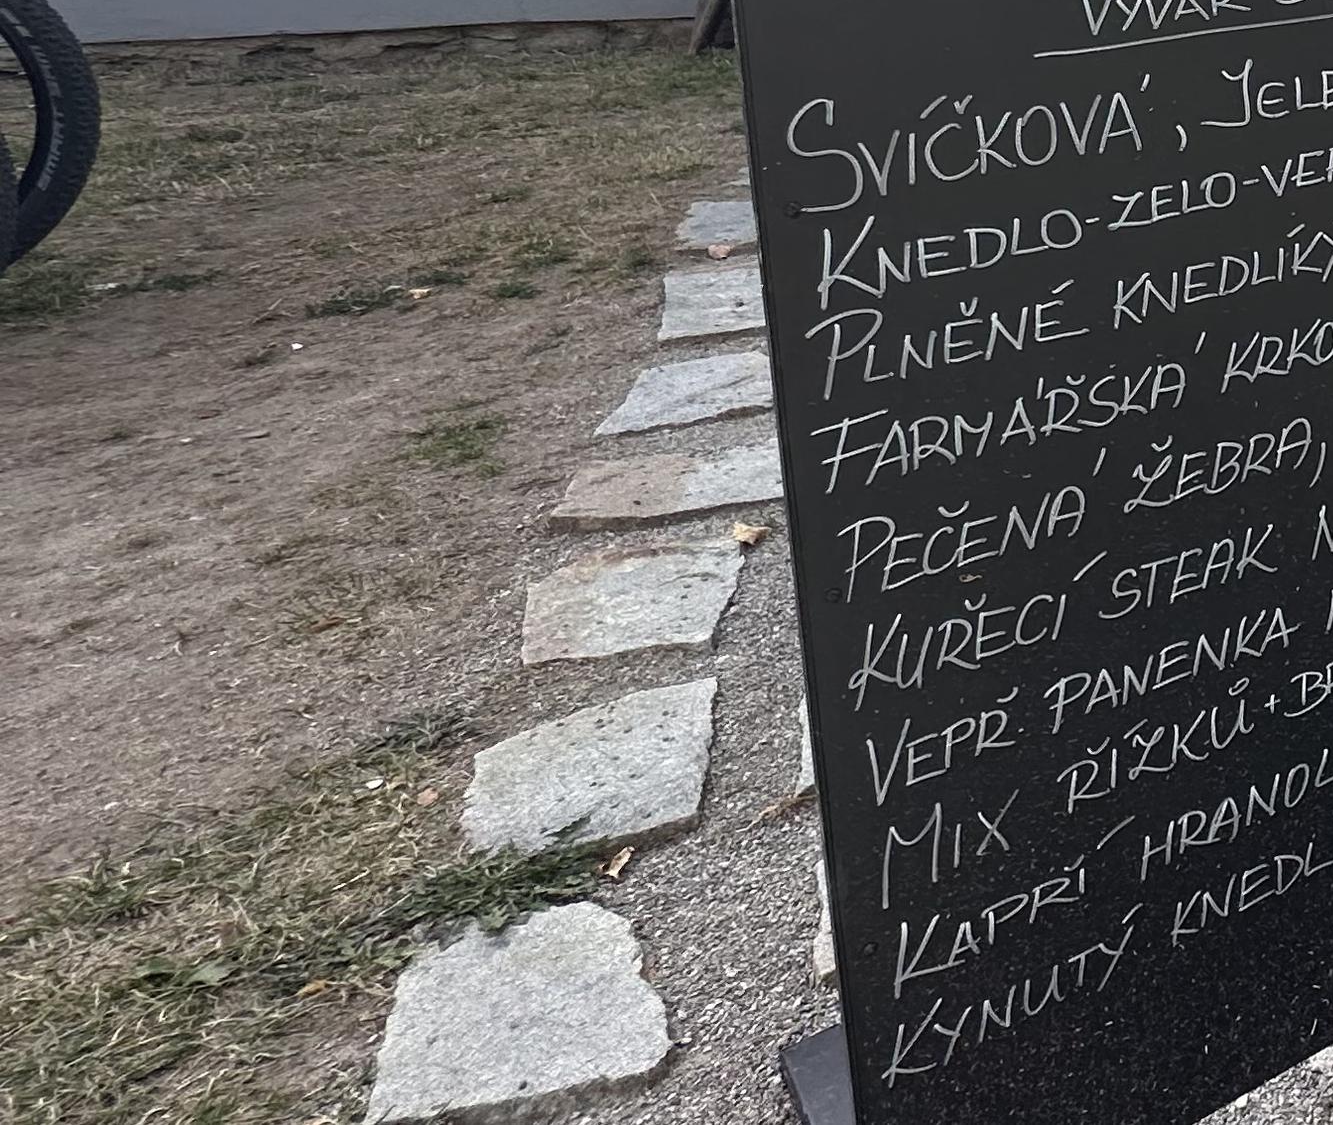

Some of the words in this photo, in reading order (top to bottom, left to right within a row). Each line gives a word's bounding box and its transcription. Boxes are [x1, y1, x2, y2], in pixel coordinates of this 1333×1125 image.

[804, 278, 1090, 401] PLNĚNÉ
[837, 447, 1107, 603] PEČENÁ
[1123, 434, 1327, 514] ŽEBRA,
[848, 550, 1108, 712] KUŘECÍ
[1098, 523, 1279, 620] STEAK
[1043, 606, 1302, 735] PANENKA
[882, 788, 1019, 909] MIX
[894, 815, 1136, 999] KAPŘÍ
[880, 902, 1144, 1089] KYNUTÝ
